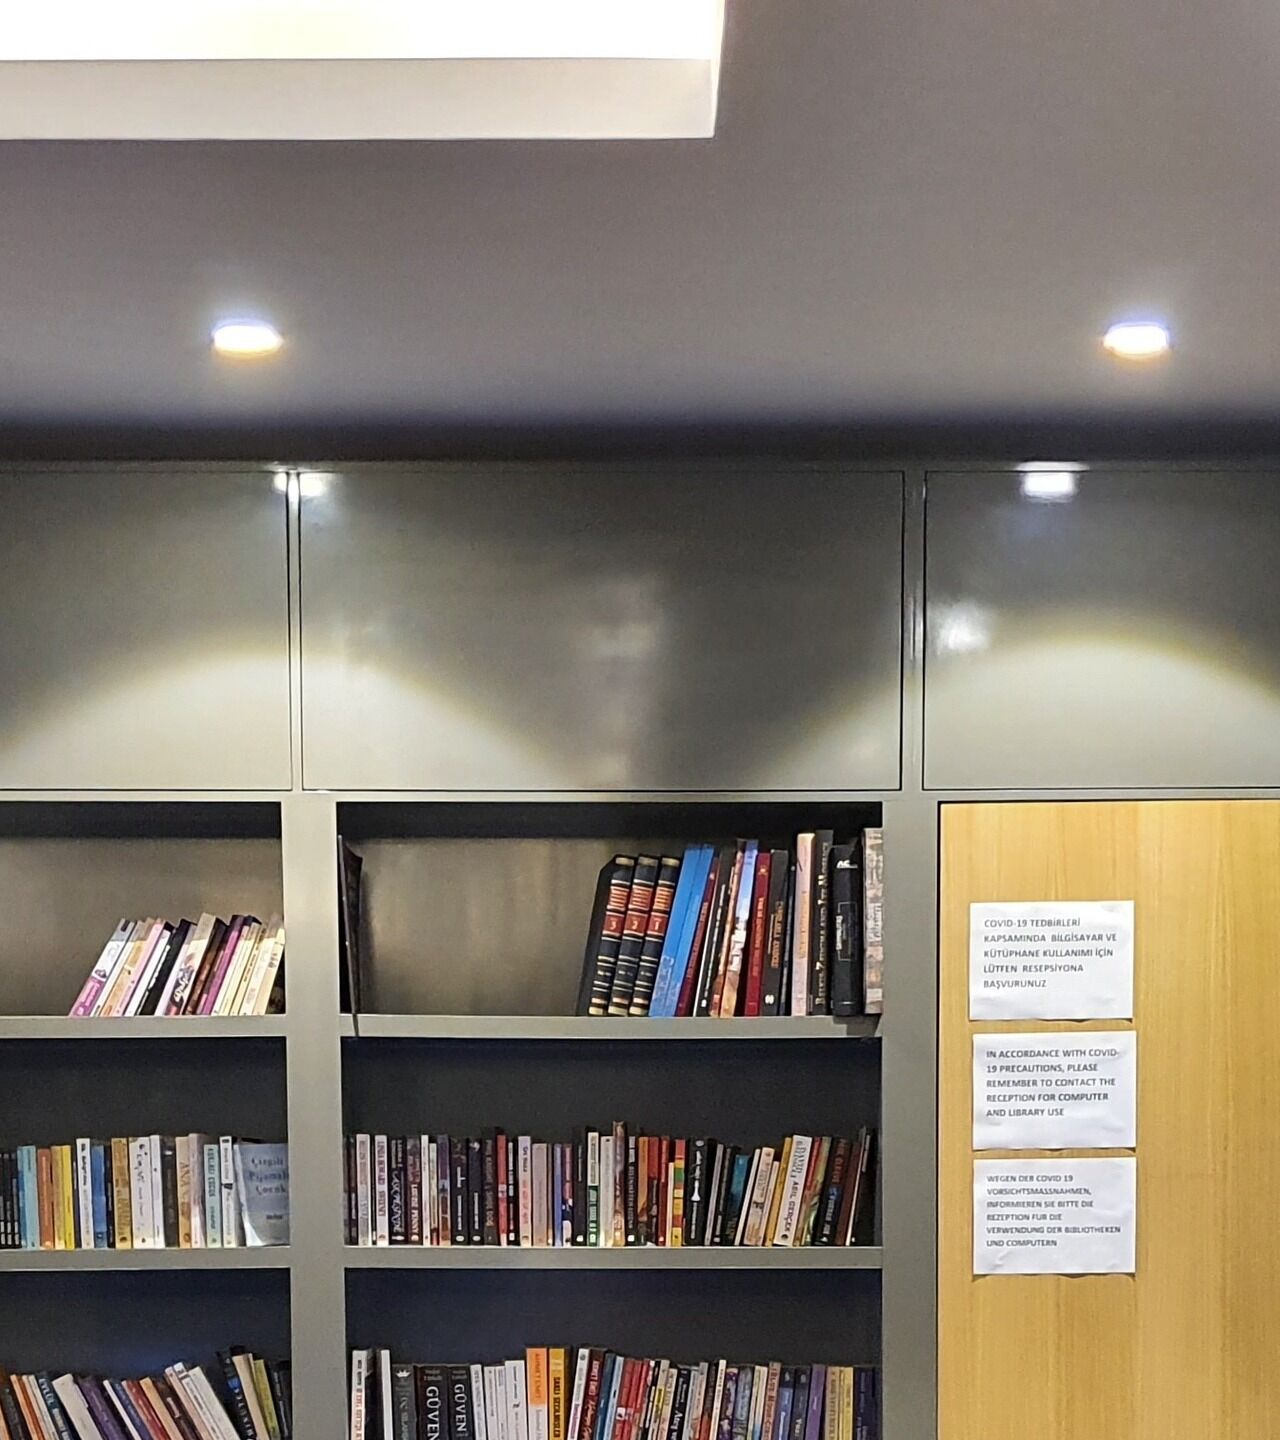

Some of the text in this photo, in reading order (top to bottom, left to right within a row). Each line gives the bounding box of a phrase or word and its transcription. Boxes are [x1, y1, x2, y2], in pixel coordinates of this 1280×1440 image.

[983, 917, 1081, 928] COVID-19 TEDBİRLERİ
[983, 931, 1118, 943] KAPSAMINDA BİLGİSAYAR VE
[983, 947, 1114, 959] KÜTÜPHANE KULLANIMI İÇİN
[983, 963, 1084, 974] LÜTFEN RESEPSİYONA
[983, 979, 1047, 990] BAŞVURUNUZ
[985, 1050, 997, 1059] IN
[998, 1049, 1060, 1059] ACCORDANCE
[1062, 1049, 1087, 1058] WITH
[986, 1063, 1099, 1074] 19 PRECAUTIONS, PLEASE
[986, 1077, 1116, 1088] REMEMBER TO CONTACT THE
[986, 1092, 1109, 1103] RECEPTION FOR COMPUTER
[985, 1107, 1065, 1119] AND LIBRARY USE
